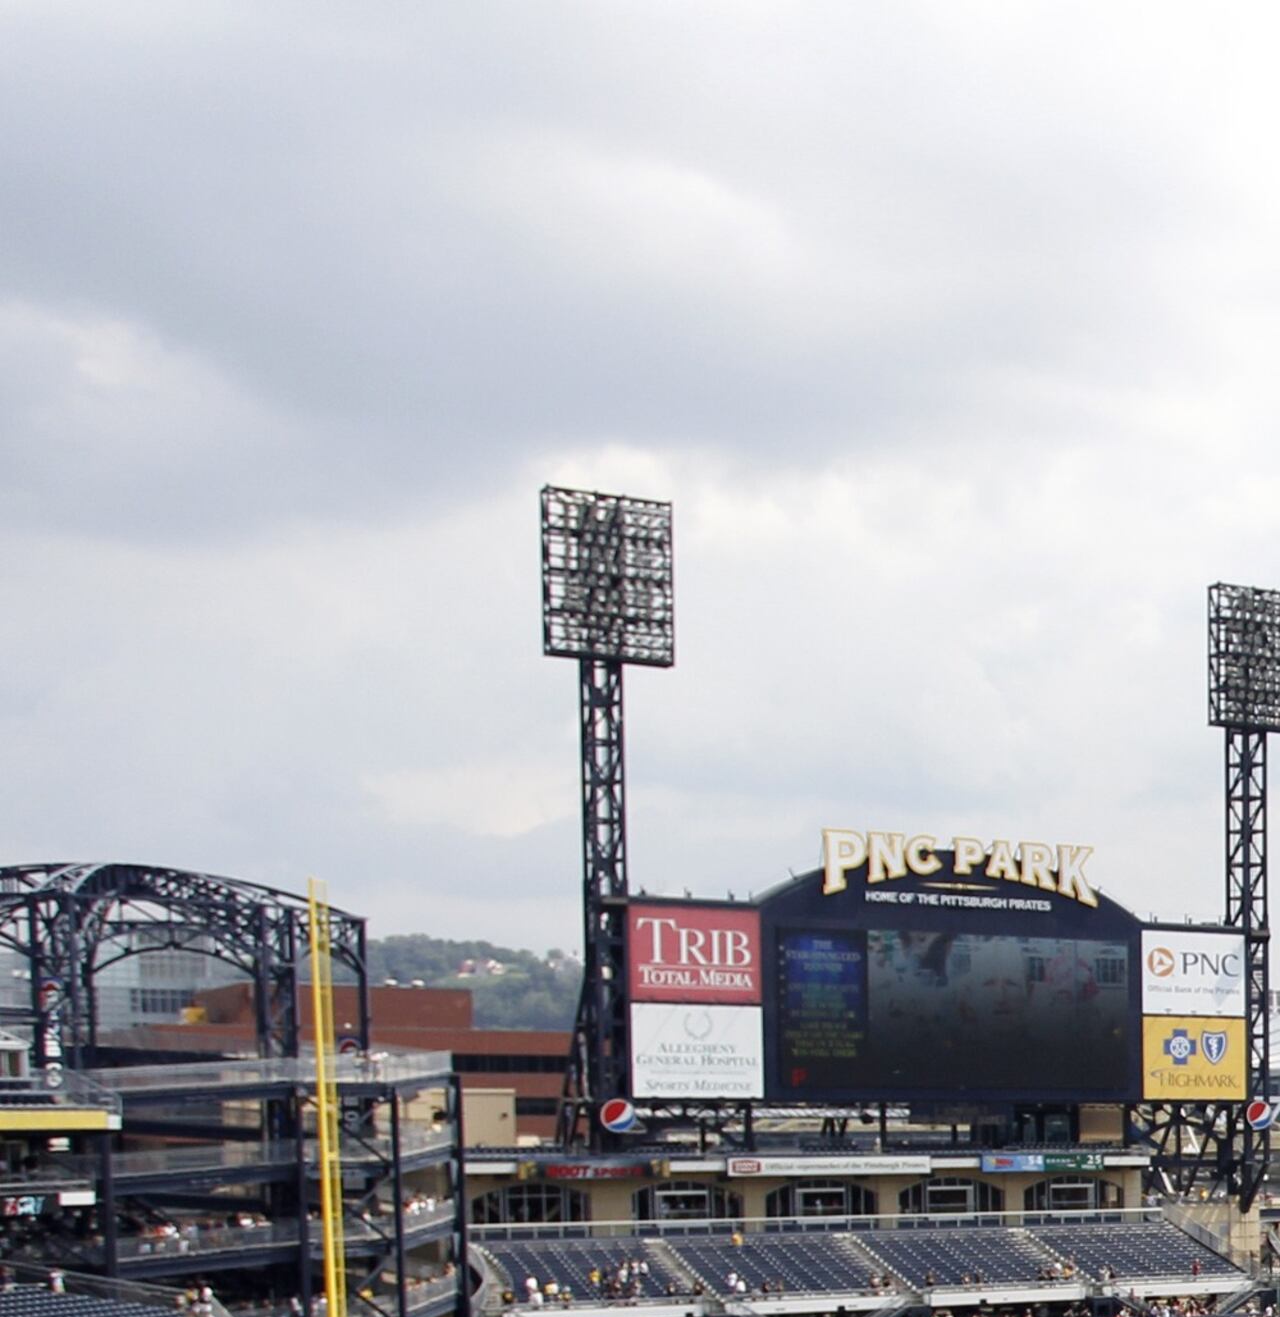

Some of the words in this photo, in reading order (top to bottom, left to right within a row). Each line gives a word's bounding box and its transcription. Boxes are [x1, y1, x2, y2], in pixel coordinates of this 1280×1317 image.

[821, 828, 943, 896] PNC
[952, 837, 1099, 908] PARK
[865, 890, 897, 903] HOME
[899, 892, 914, 904] OF
[917, 894, 938, 905] THE
[940, 895, 1007, 909] PITTSBURGH
[1008, 898, 1052, 912] PIRATES
[636, 917, 752, 967] TRIB
[1180, 952, 1240, 978] PNC
[638, 965, 696, 986] TOTAL
[699, 969, 753, 988] MEDIA
[658, 1042, 737, 1055] ALLEGHENY
[636, 1054, 696, 1067] GENERAL
[701, 1055, 758, 1068] HOSPITAL
[1158, 1069, 1240, 1089] HIGHMARK
